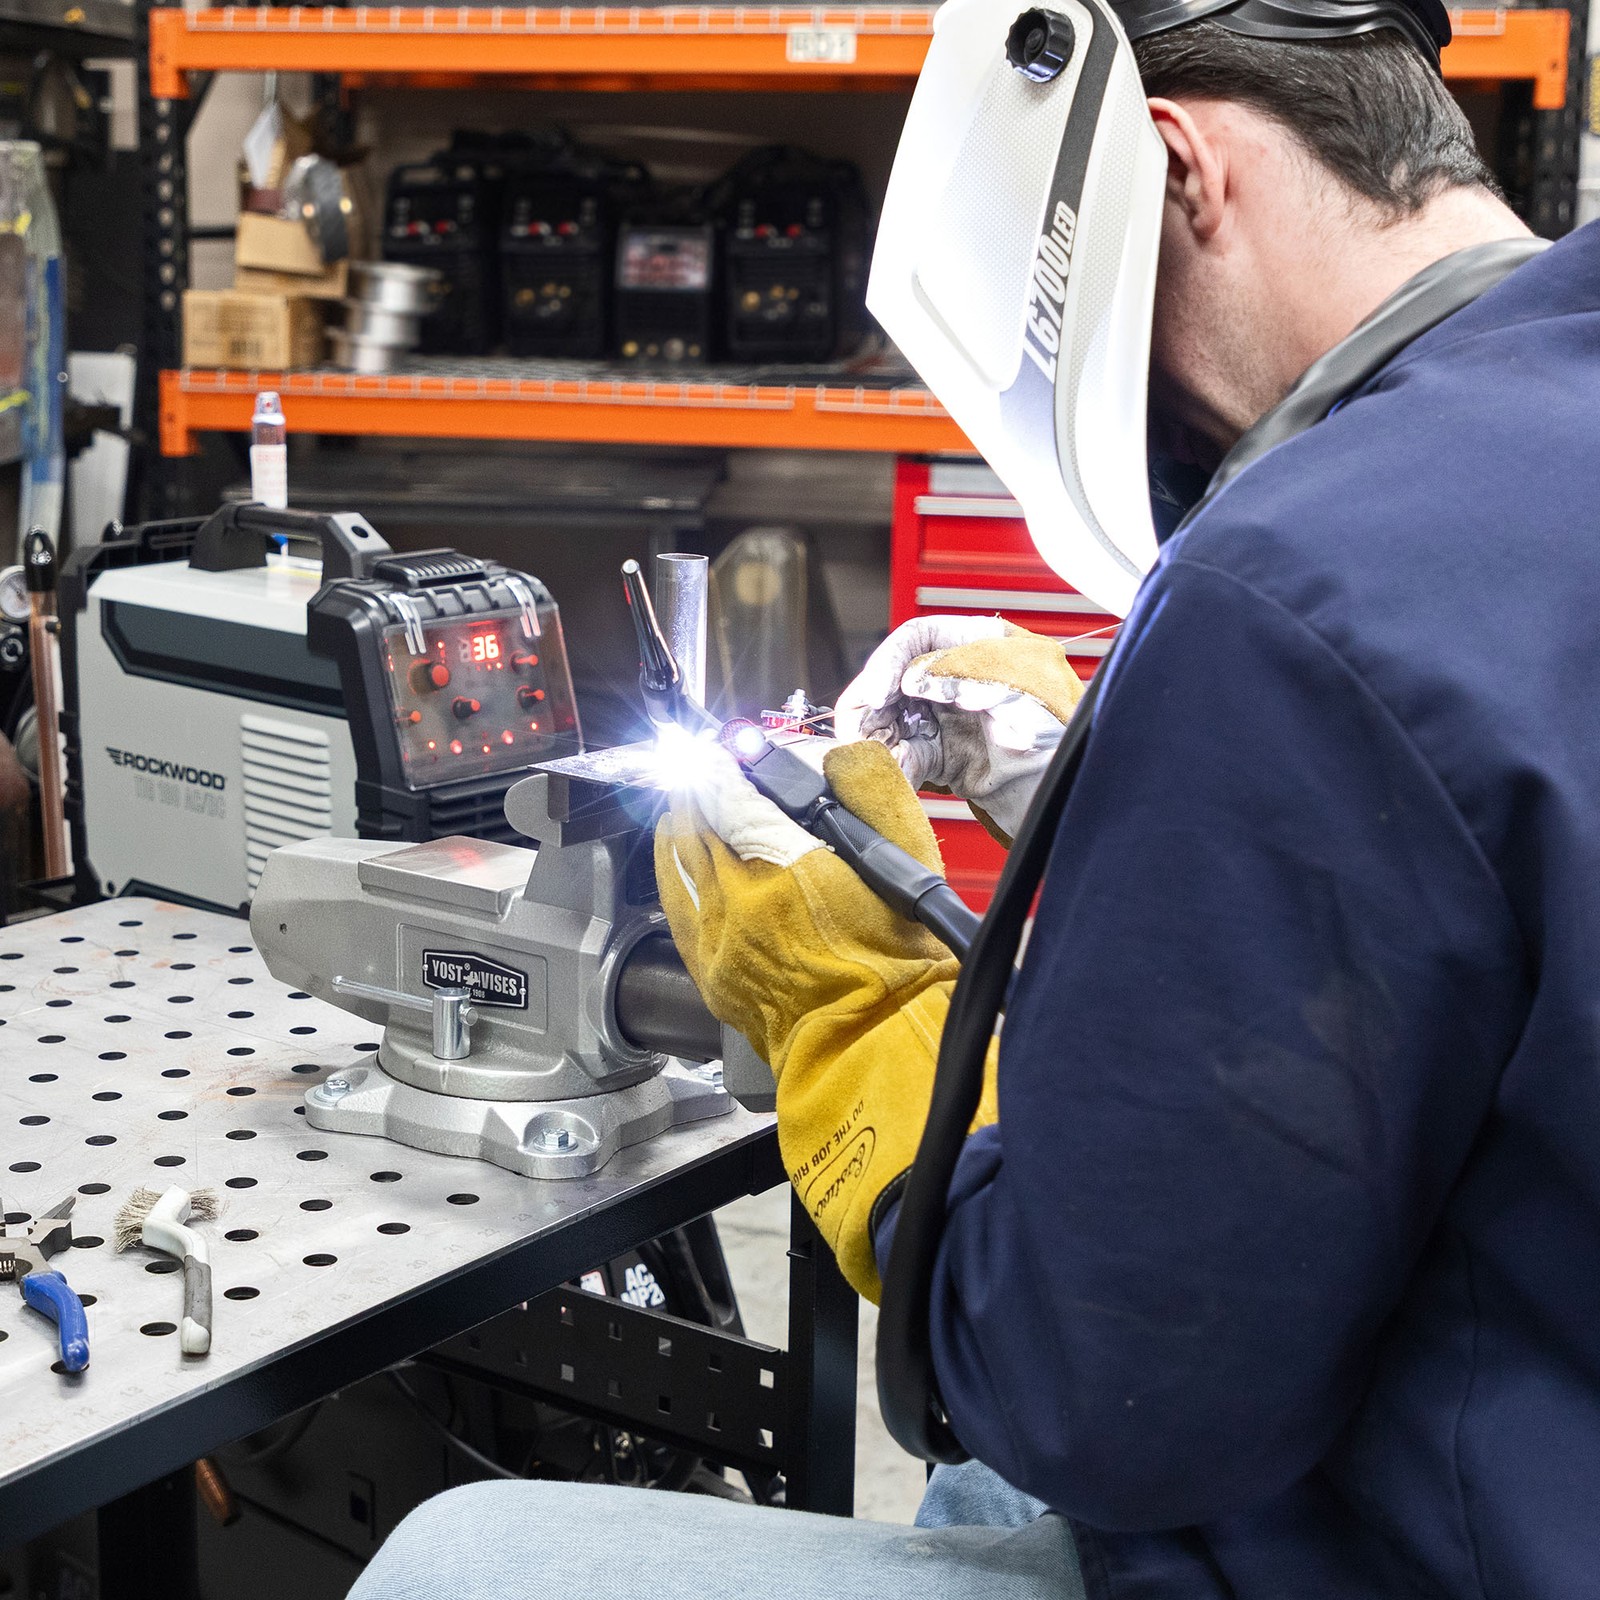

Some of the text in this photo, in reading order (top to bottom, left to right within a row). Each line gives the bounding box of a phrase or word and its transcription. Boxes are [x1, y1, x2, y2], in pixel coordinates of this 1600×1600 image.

[473, 635, 499, 661] 36
[122, 751, 225, 791] ROCKWOOD
[432, 959, 517, 997] YOST VISES
[852, 1100, 865, 1122] DO
[833, 1120, 852, 1147] THE
[812, 1141, 831, 1168] JOB
